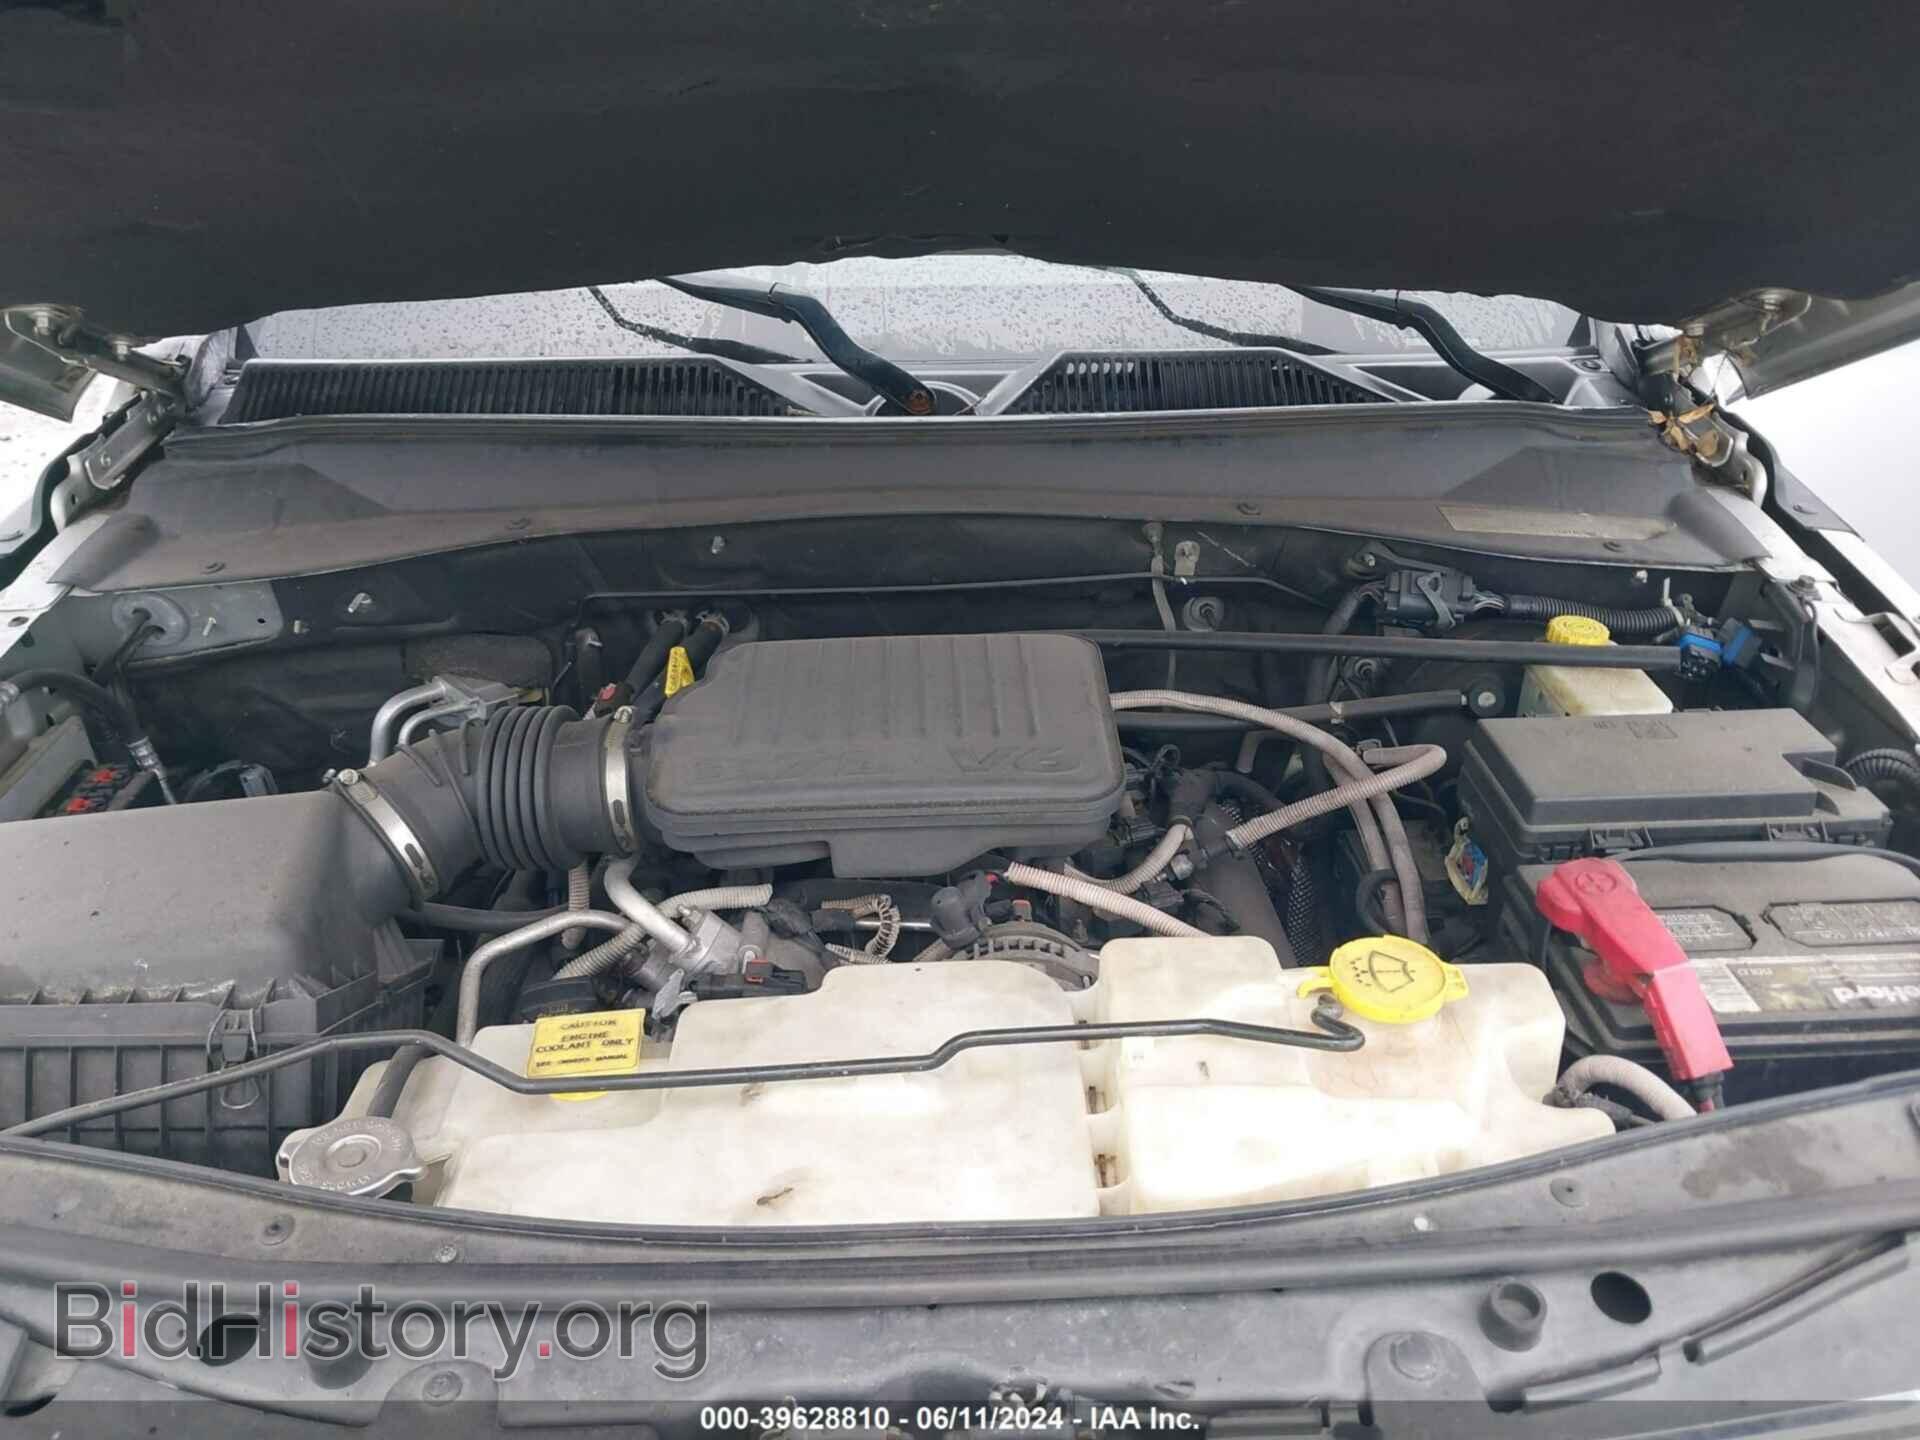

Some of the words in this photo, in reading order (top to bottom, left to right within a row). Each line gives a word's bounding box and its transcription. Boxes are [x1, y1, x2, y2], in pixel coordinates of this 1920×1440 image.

[561, 1031, 609, 1042] ENGINE
[536, 1041, 591, 1053] COOLANT
[602, 1038, 635, 1046] ONLY
